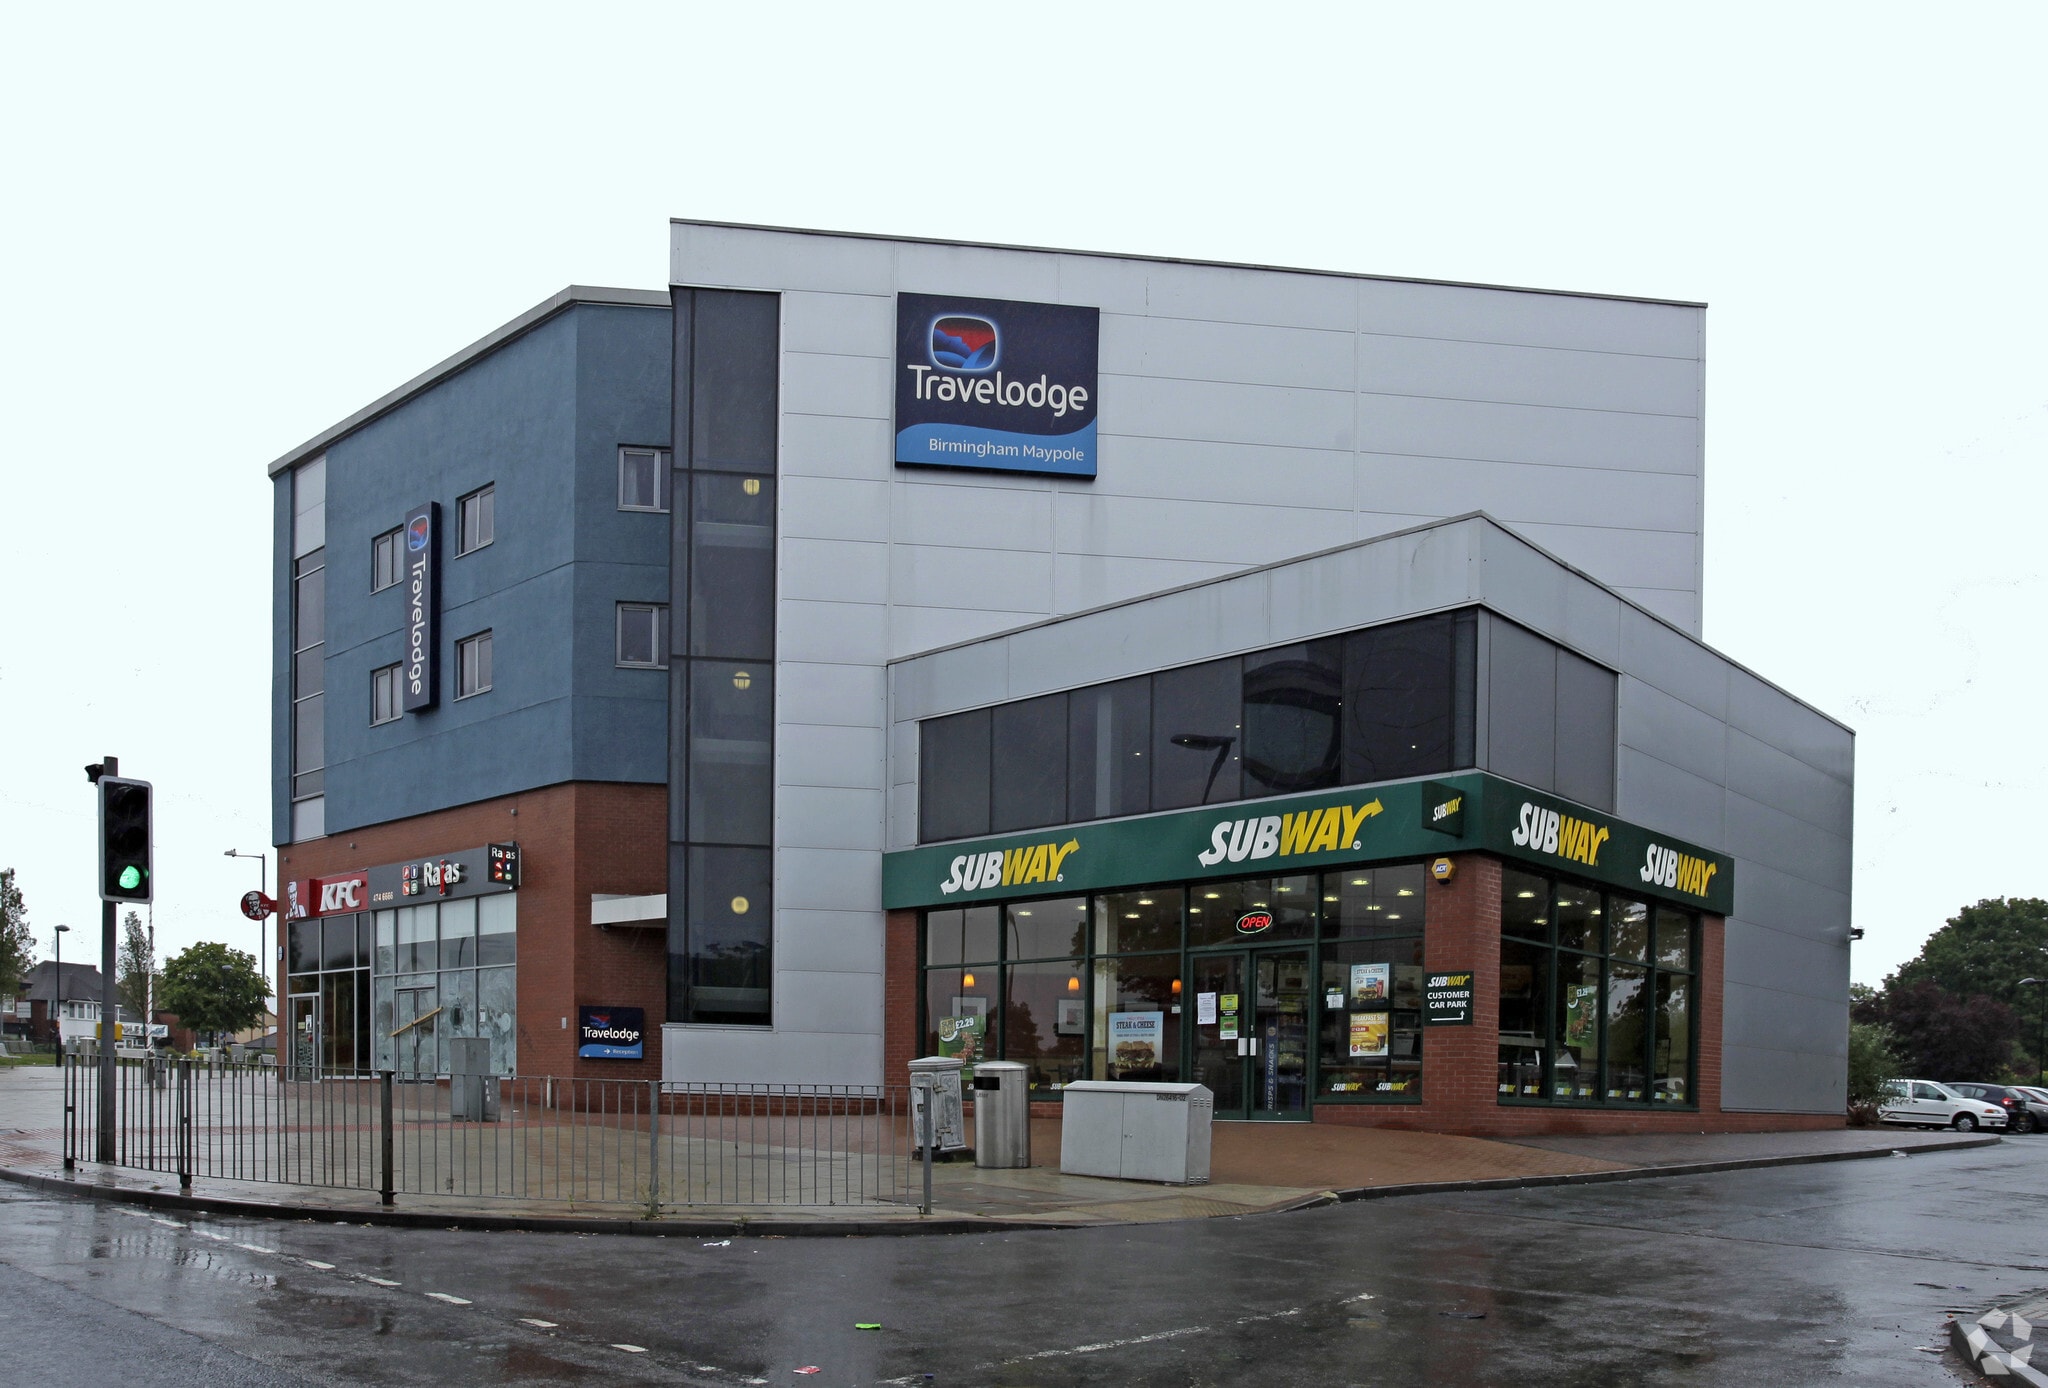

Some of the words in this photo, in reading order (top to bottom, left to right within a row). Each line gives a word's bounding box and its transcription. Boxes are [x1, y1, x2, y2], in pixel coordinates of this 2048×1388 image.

[907, 364, 1089, 418] Travelodge
[929, 438, 1019, 457] Birmingham
[1023, 444, 1085, 463] Maypole
[408, 552, 426, 696] Travelodge
[1432, 796, 1462, 822] SUBWAY
[1197, 797, 1384, 868] SUBWAY
[1511, 802, 1610, 866] SUBWAY
[491, 847, 516, 863] Rajas
[940, 837, 1081, 895] SUBWAY
[1640, 843, 1717, 897] SUBWAY
[423, 859, 460, 897] Rajas
[319, 879, 362, 912] KFC
[1241, 916, 1270, 928] OPEN
[1427, 975, 1470, 988] SUBWAY
[1427, 991, 1470, 1000] CUSTOMER
[1429, 1001, 1445, 1009] CAR
[1446, 1000, 1468, 1008] PARK
[955, 1017, 974, 1029] £2.29
[1116, 1020, 1132, 1029] STEAK
[1137, 1020, 1156, 1028] CHEESE
[582, 1026, 640, 1042] Travelodge
[1331, 1083, 1362, 1091] SUBWAY
[1376, 1083, 1408, 1091] SUBWAY
